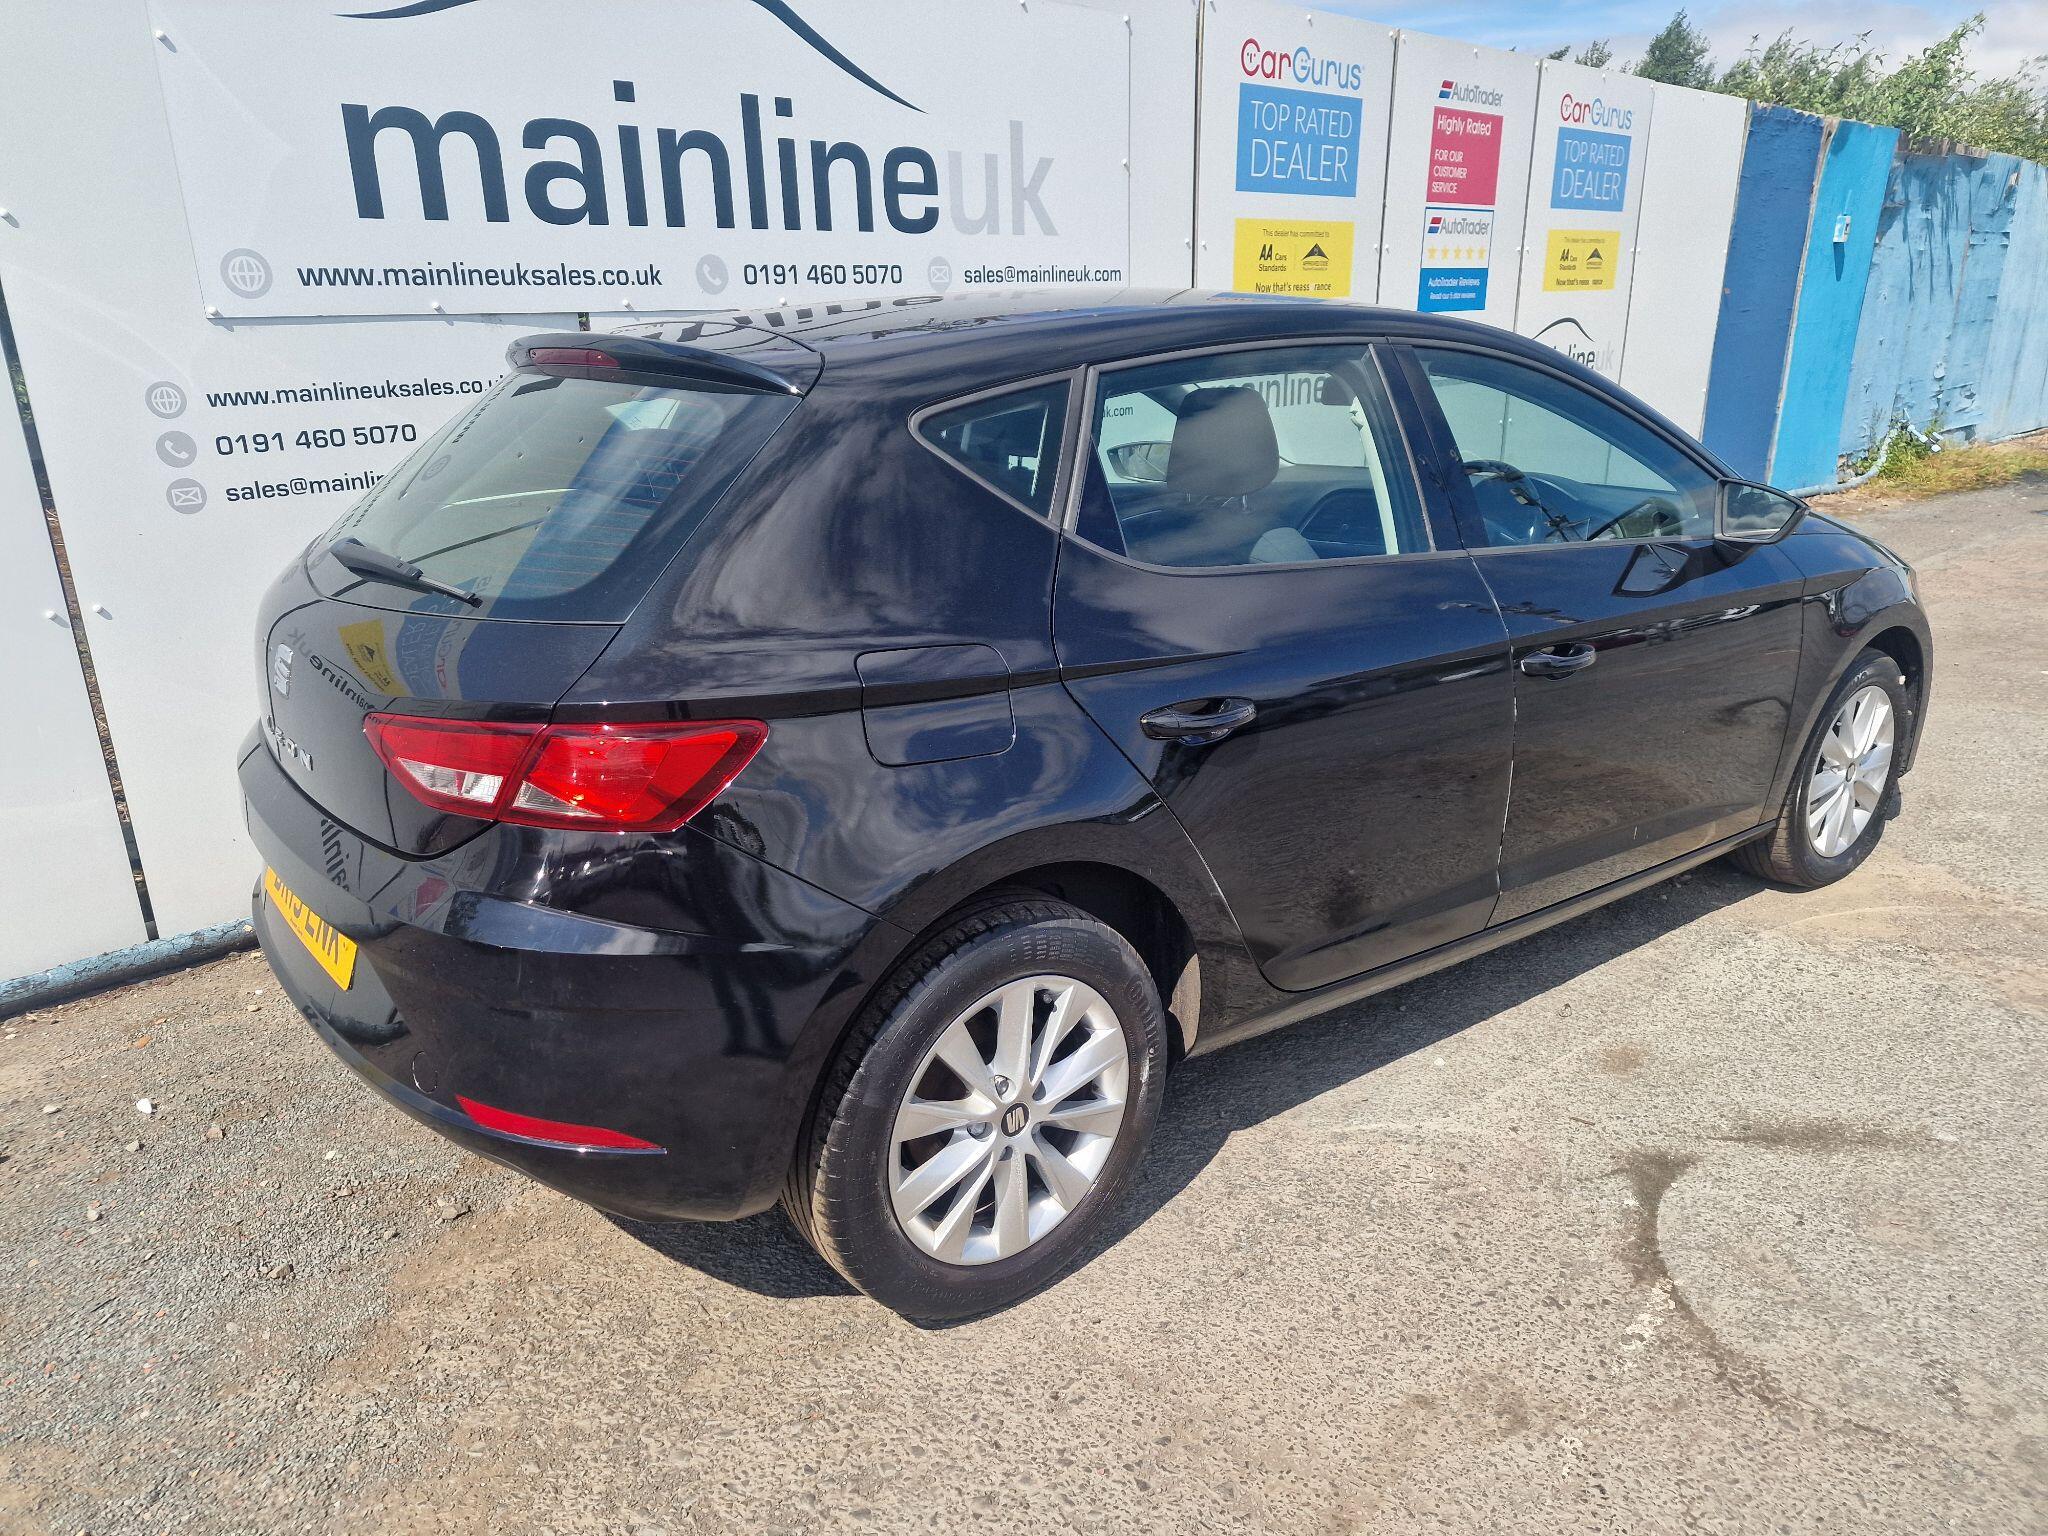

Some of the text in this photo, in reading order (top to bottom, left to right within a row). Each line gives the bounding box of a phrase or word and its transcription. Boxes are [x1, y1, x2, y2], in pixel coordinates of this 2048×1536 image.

[1241, 38, 1362, 91] CarGurus
[1451, 82, 1503, 107] AutoTrader
[1251, 100, 1353, 138] TOP RATED
[1561, 93, 1632, 130] CarGurus
[1437, 114, 1492, 136] Highly Rated
[1251, 138, 1348, 183] DEALER
[1434, 149, 1463, 162] FOR OUR
[1564, 139, 1625, 167] TOP RATED
[1433, 165, 1467, 179] CUSTOMER
[1432, 181, 1458, 194] SERVICE
[1561, 168, 1621, 201] DEALER
[1440, 217, 1489, 236] AutoTrader
[1259, 244, 1273, 261] AA
[297, 261, 663, 287] www.mainlineuksales.co.uk
[744, 265, 903, 286] 0191 460 5070
[964, 264, 1122, 285] sales@mainlineuk.com
[1258, 264, 1286, 272] Standards
[1255, 282, 1270, 293] Now
[1273, 281, 1291, 292] that's
[206, 374, 503, 408] www.mainlineuksales.co
[215, 423, 417, 456] 0191 460 5070
